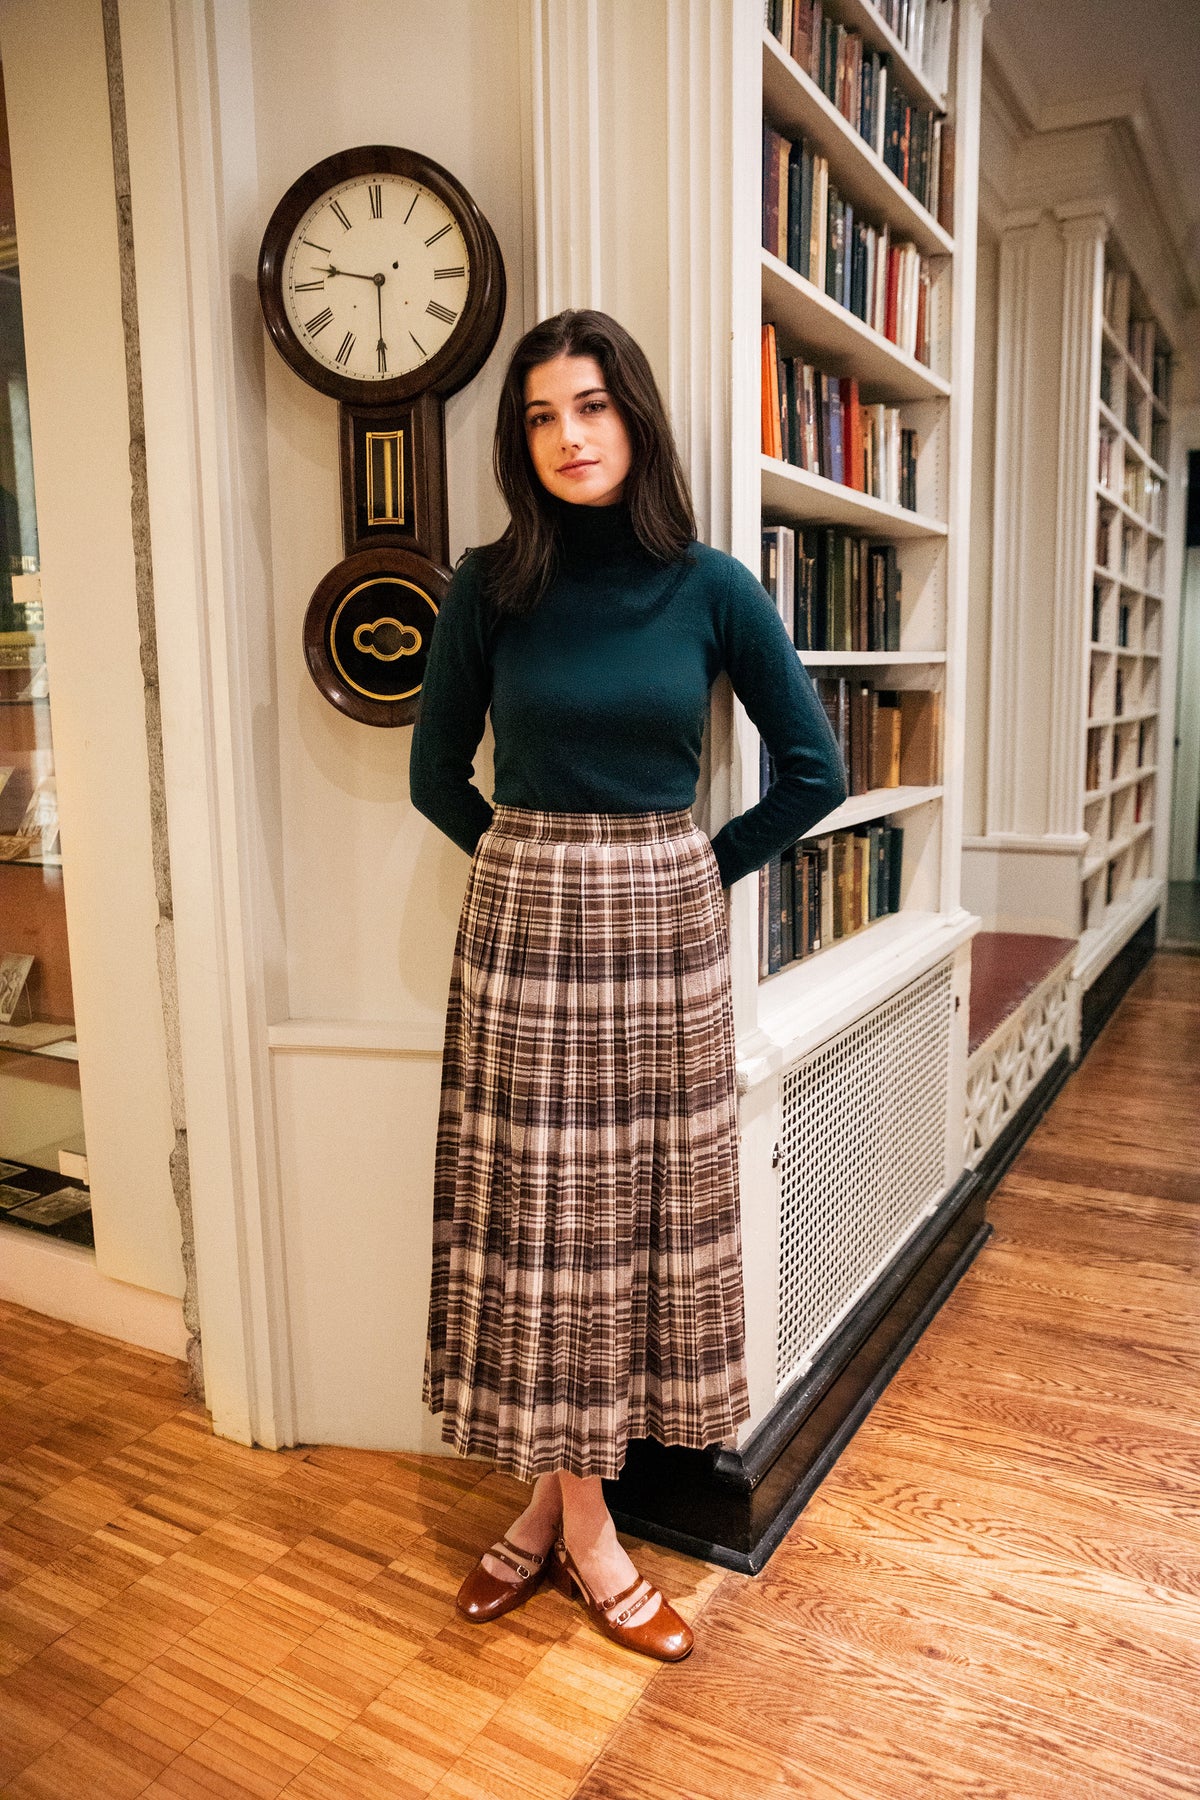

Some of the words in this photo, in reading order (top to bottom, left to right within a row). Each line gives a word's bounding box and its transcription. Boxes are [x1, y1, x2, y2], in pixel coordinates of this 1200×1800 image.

[368, 184, 384, 220] XII
[403, 193, 420, 225] I
[424, 222, 453, 248] II
[433, 265, 465, 280] III
[304, 306, 336, 339] VIII
[425, 299, 458, 325] IIII
[335, 330, 357, 366] VII
